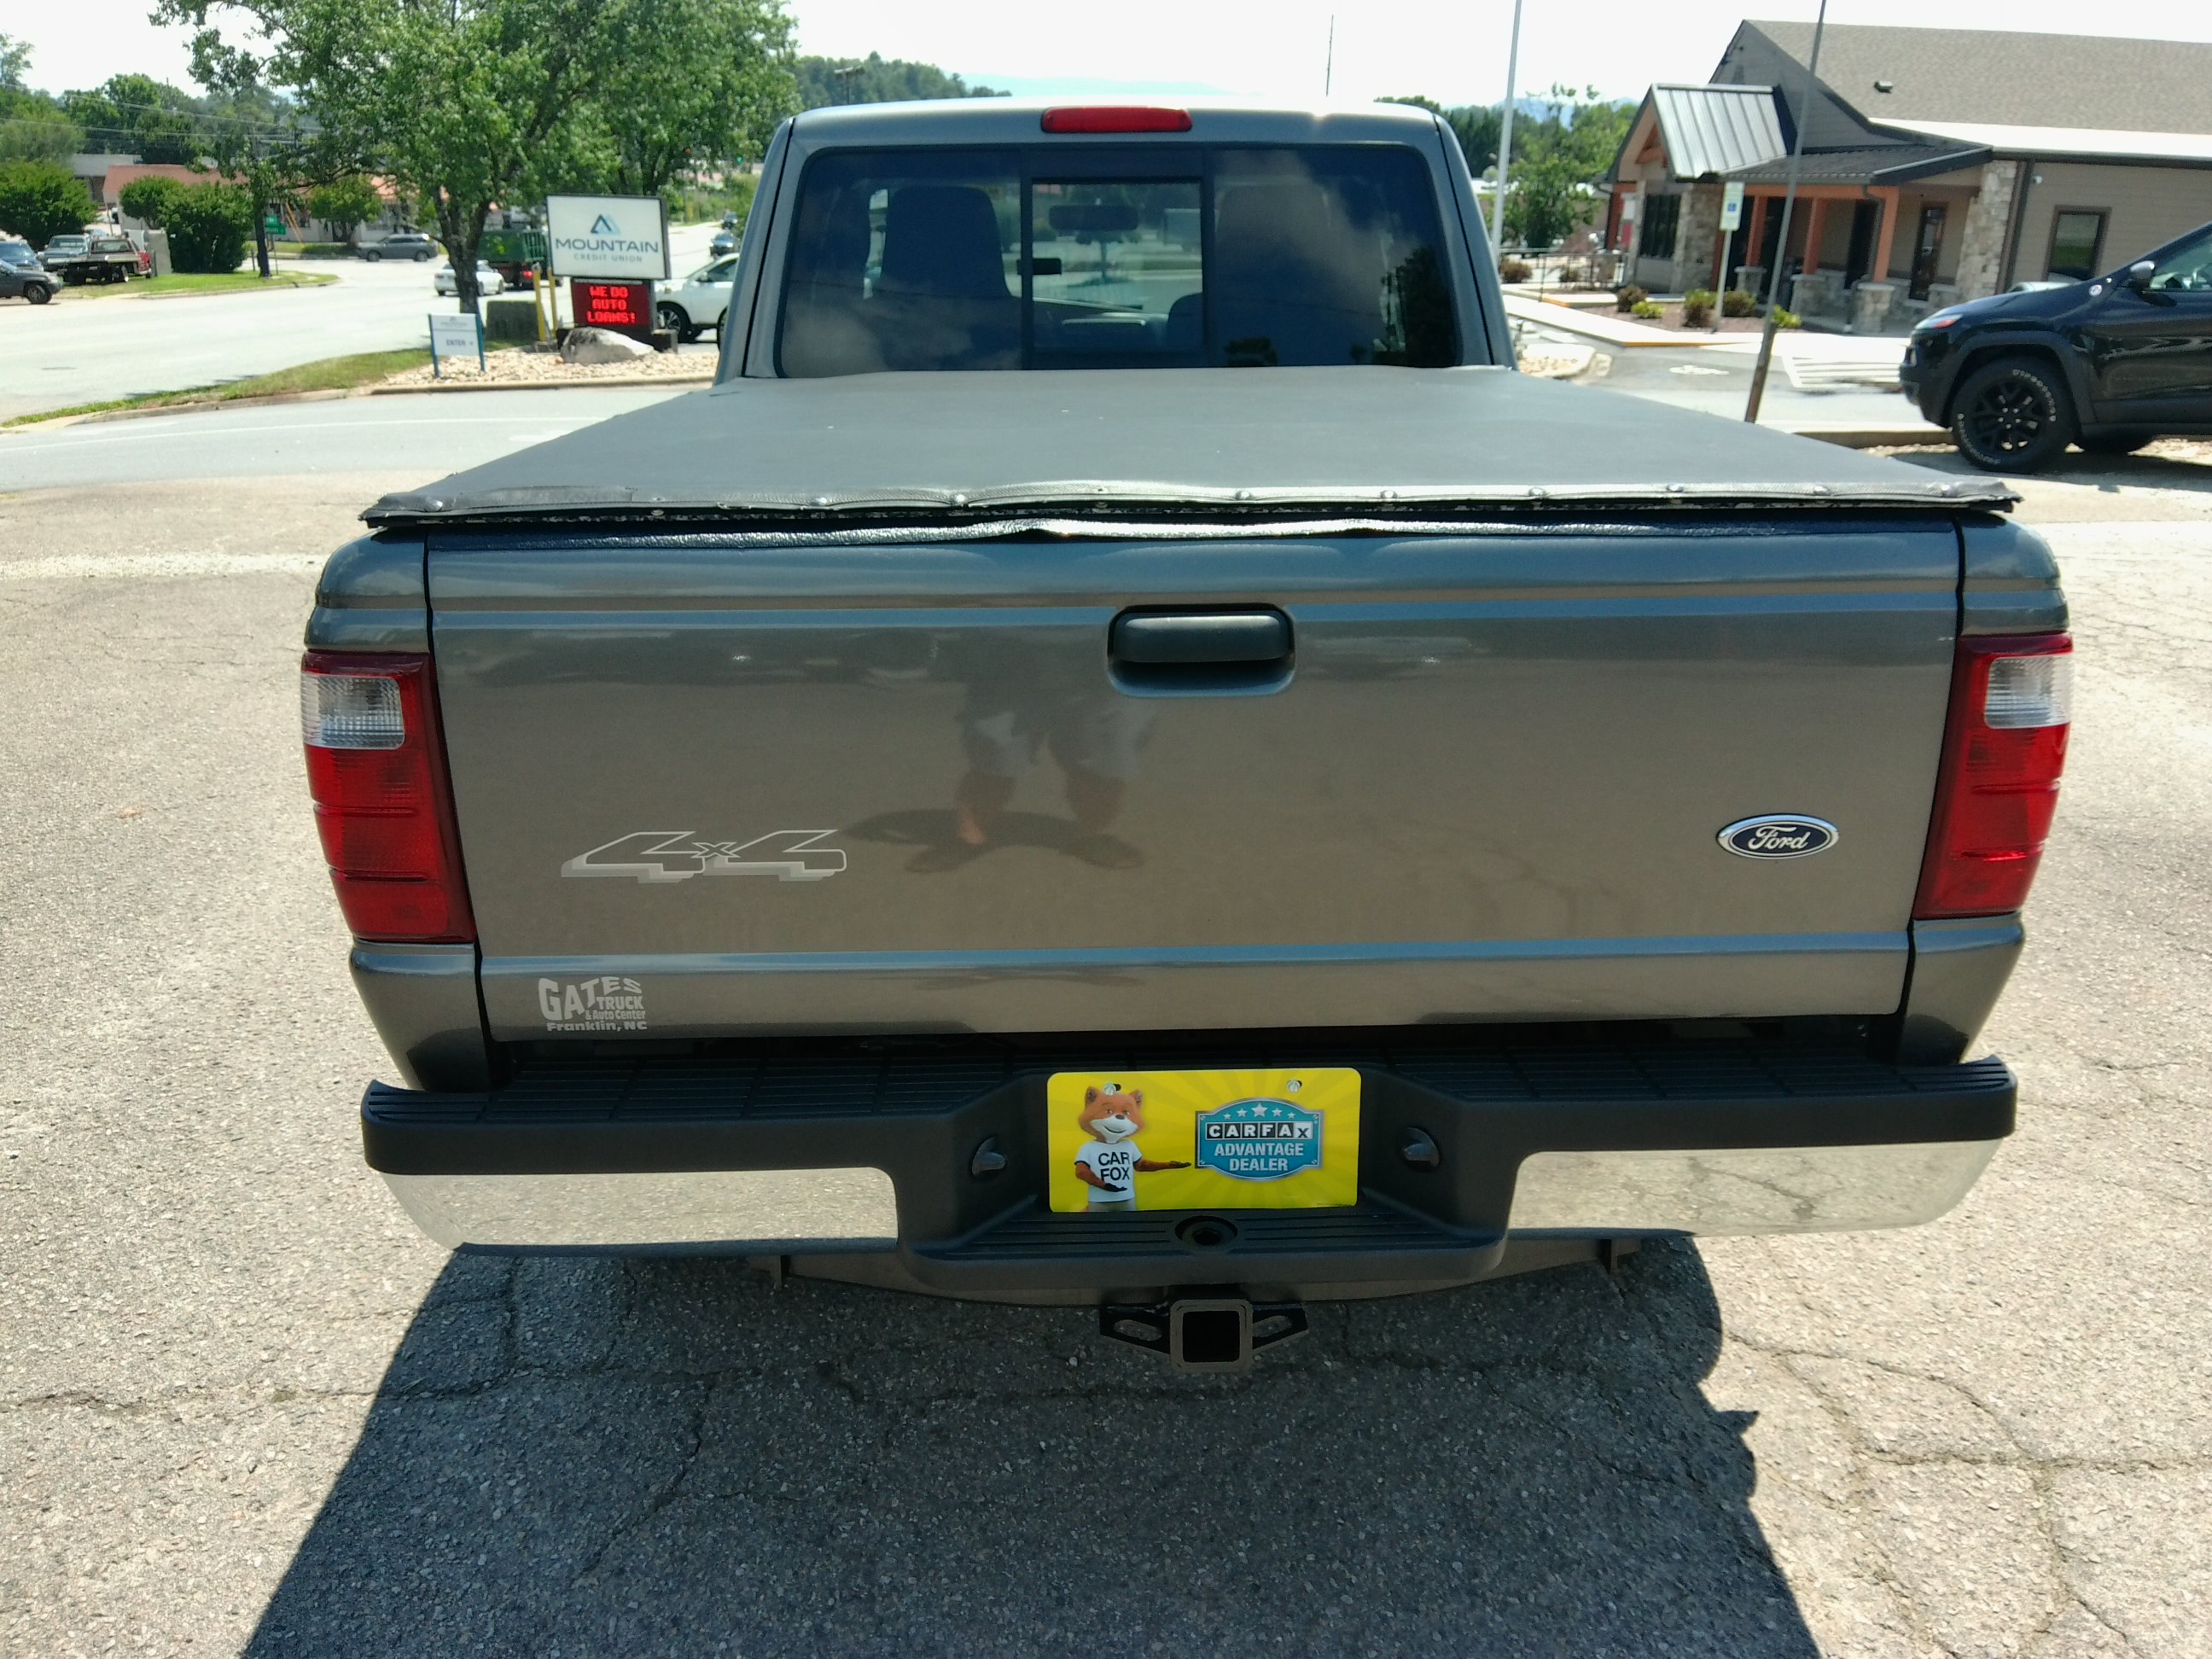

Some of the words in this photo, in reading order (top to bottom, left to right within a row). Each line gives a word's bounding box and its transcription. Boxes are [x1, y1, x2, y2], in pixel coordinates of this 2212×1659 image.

[556, 238, 658, 253] MOUNTAIN
[590, 286, 608, 297] WE
[610, 286, 629, 298] DO
[592, 299, 627, 310] AUTO
[586, 311, 636, 323] LOANS!
[1748, 826, 1811, 850] Ford
[538, 976, 643, 1021] GATES
[596, 996, 644, 1010] TRUCK
[585, 1010, 592, 1020] &
[593, 1010, 614, 1020] Auto
[615, 1010, 646, 1019] Center
[546, 1021, 621, 1032] Franklin,
[624, 1021, 647, 1030] NC
[1207, 1123, 1312, 1139] CARFAX
[1214, 1143, 1304, 1156] ADVANTAGE
[1097, 1151, 1130, 1166] CAR
[1229, 1157, 1289, 1172] DEALER
[1100, 1166, 1130, 1182] FOX
